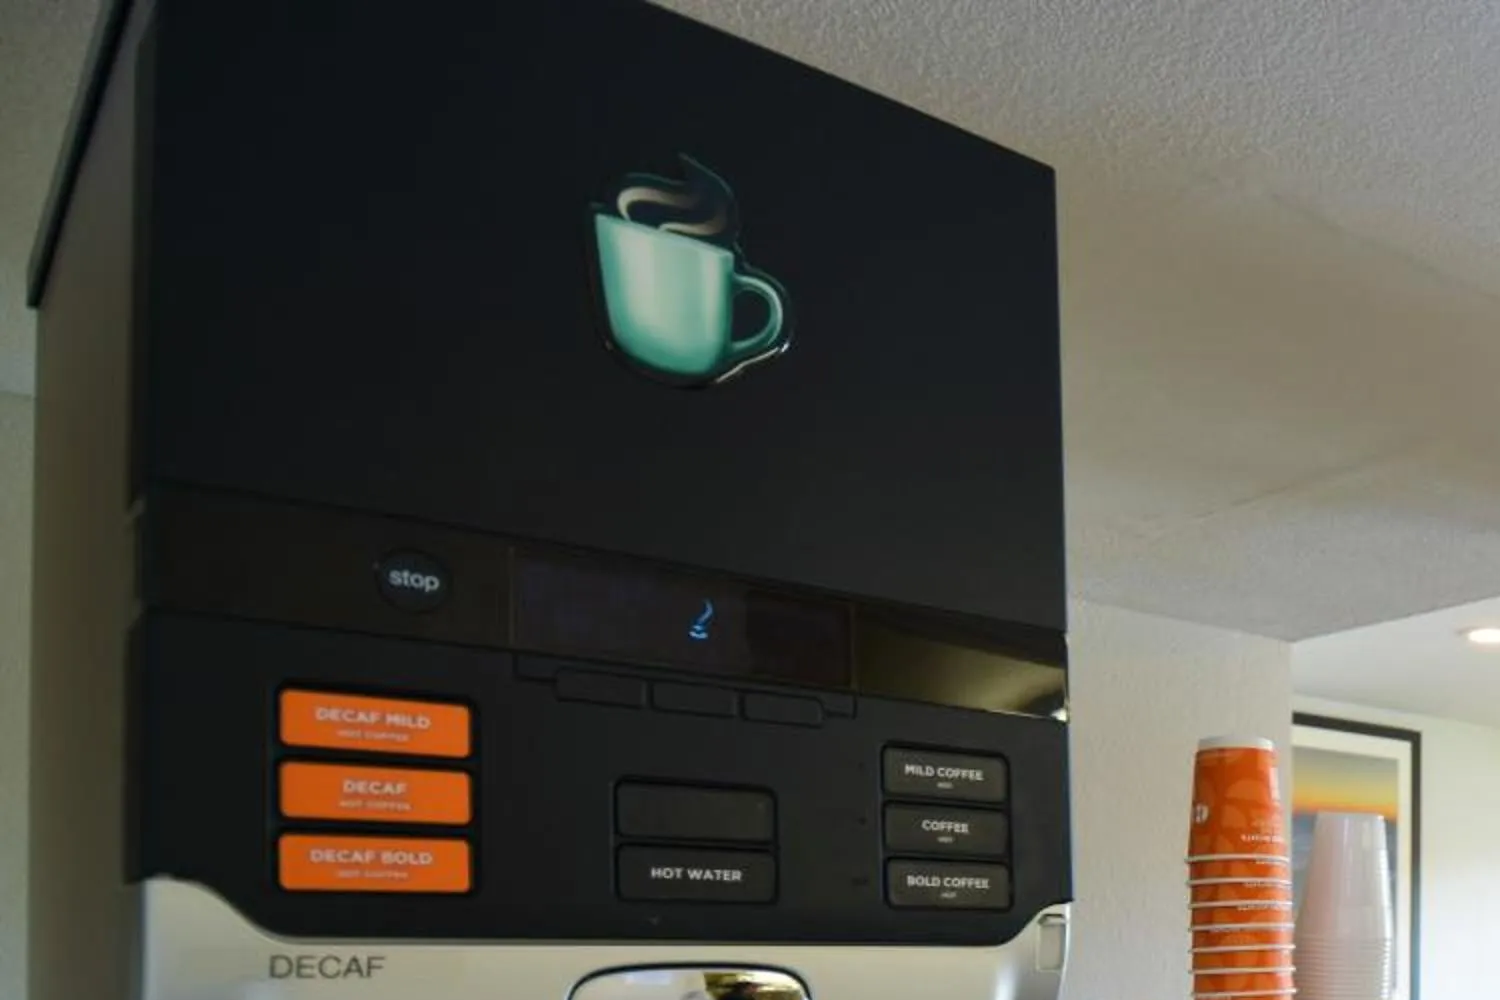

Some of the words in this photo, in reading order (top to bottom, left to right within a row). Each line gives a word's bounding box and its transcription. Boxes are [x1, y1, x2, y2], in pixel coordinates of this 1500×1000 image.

[389, 569, 440, 593] stop
[315, 706, 379, 723] DECAF
[385, 713, 431, 729] MILD
[904, 764, 935, 777] MILD
[937, 767, 984, 780] COFFEE
[342, 779, 407, 795] DECAF
[921, 819, 969, 833] COFFEE
[309, 848, 375, 864] DECAF
[381, 850, 433, 866] BOLD
[650, 867, 683, 879] HOT
[687, 868, 743, 881] WATER
[906, 874, 941, 887] BOLD
[943, 877, 990, 889] COFFEE
[269, 954, 386, 979] DECAF
